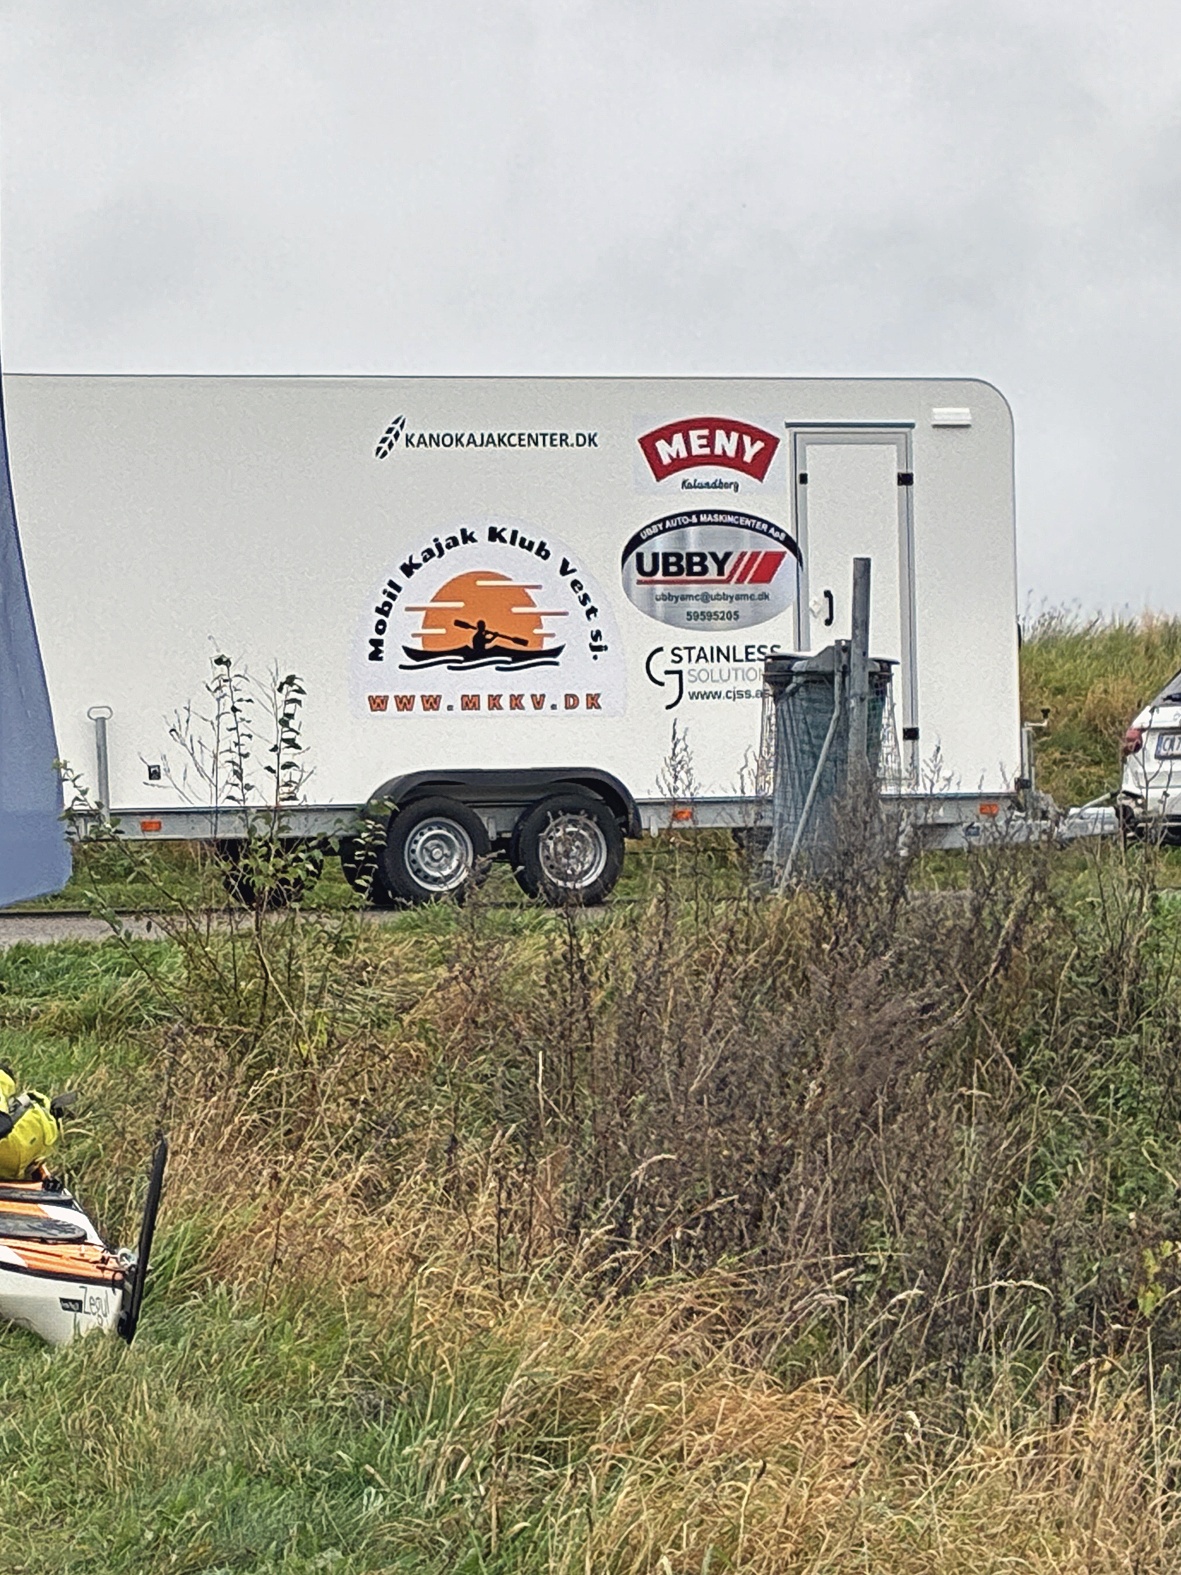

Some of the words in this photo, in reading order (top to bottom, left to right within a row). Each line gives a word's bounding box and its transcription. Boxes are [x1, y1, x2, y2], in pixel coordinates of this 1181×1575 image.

[405, 432, 599, 448] KANOKAJAKCENTER.DK
[655, 428, 765, 466] MENY
[681, 478, 739, 493] Kalundborg
[640, 524, 664, 540] UBBY
[699, 513, 769, 532] MASKINCENTER
[635, 551, 734, 577] UBBY
[368, 578, 403, 661] Mobil
[399, 527, 478, 579] Kajak
[487, 526, 551, 561] Klub
[559, 557, 599, 622] Vest
[654, 591, 771, 604] ubbyamc@ubbyamc.dk
[685, 610, 740, 622] 59595205
[687, 666, 763, 684] SOLUTIO
[368, 694, 603, 712] WWW.MKKV.DK
